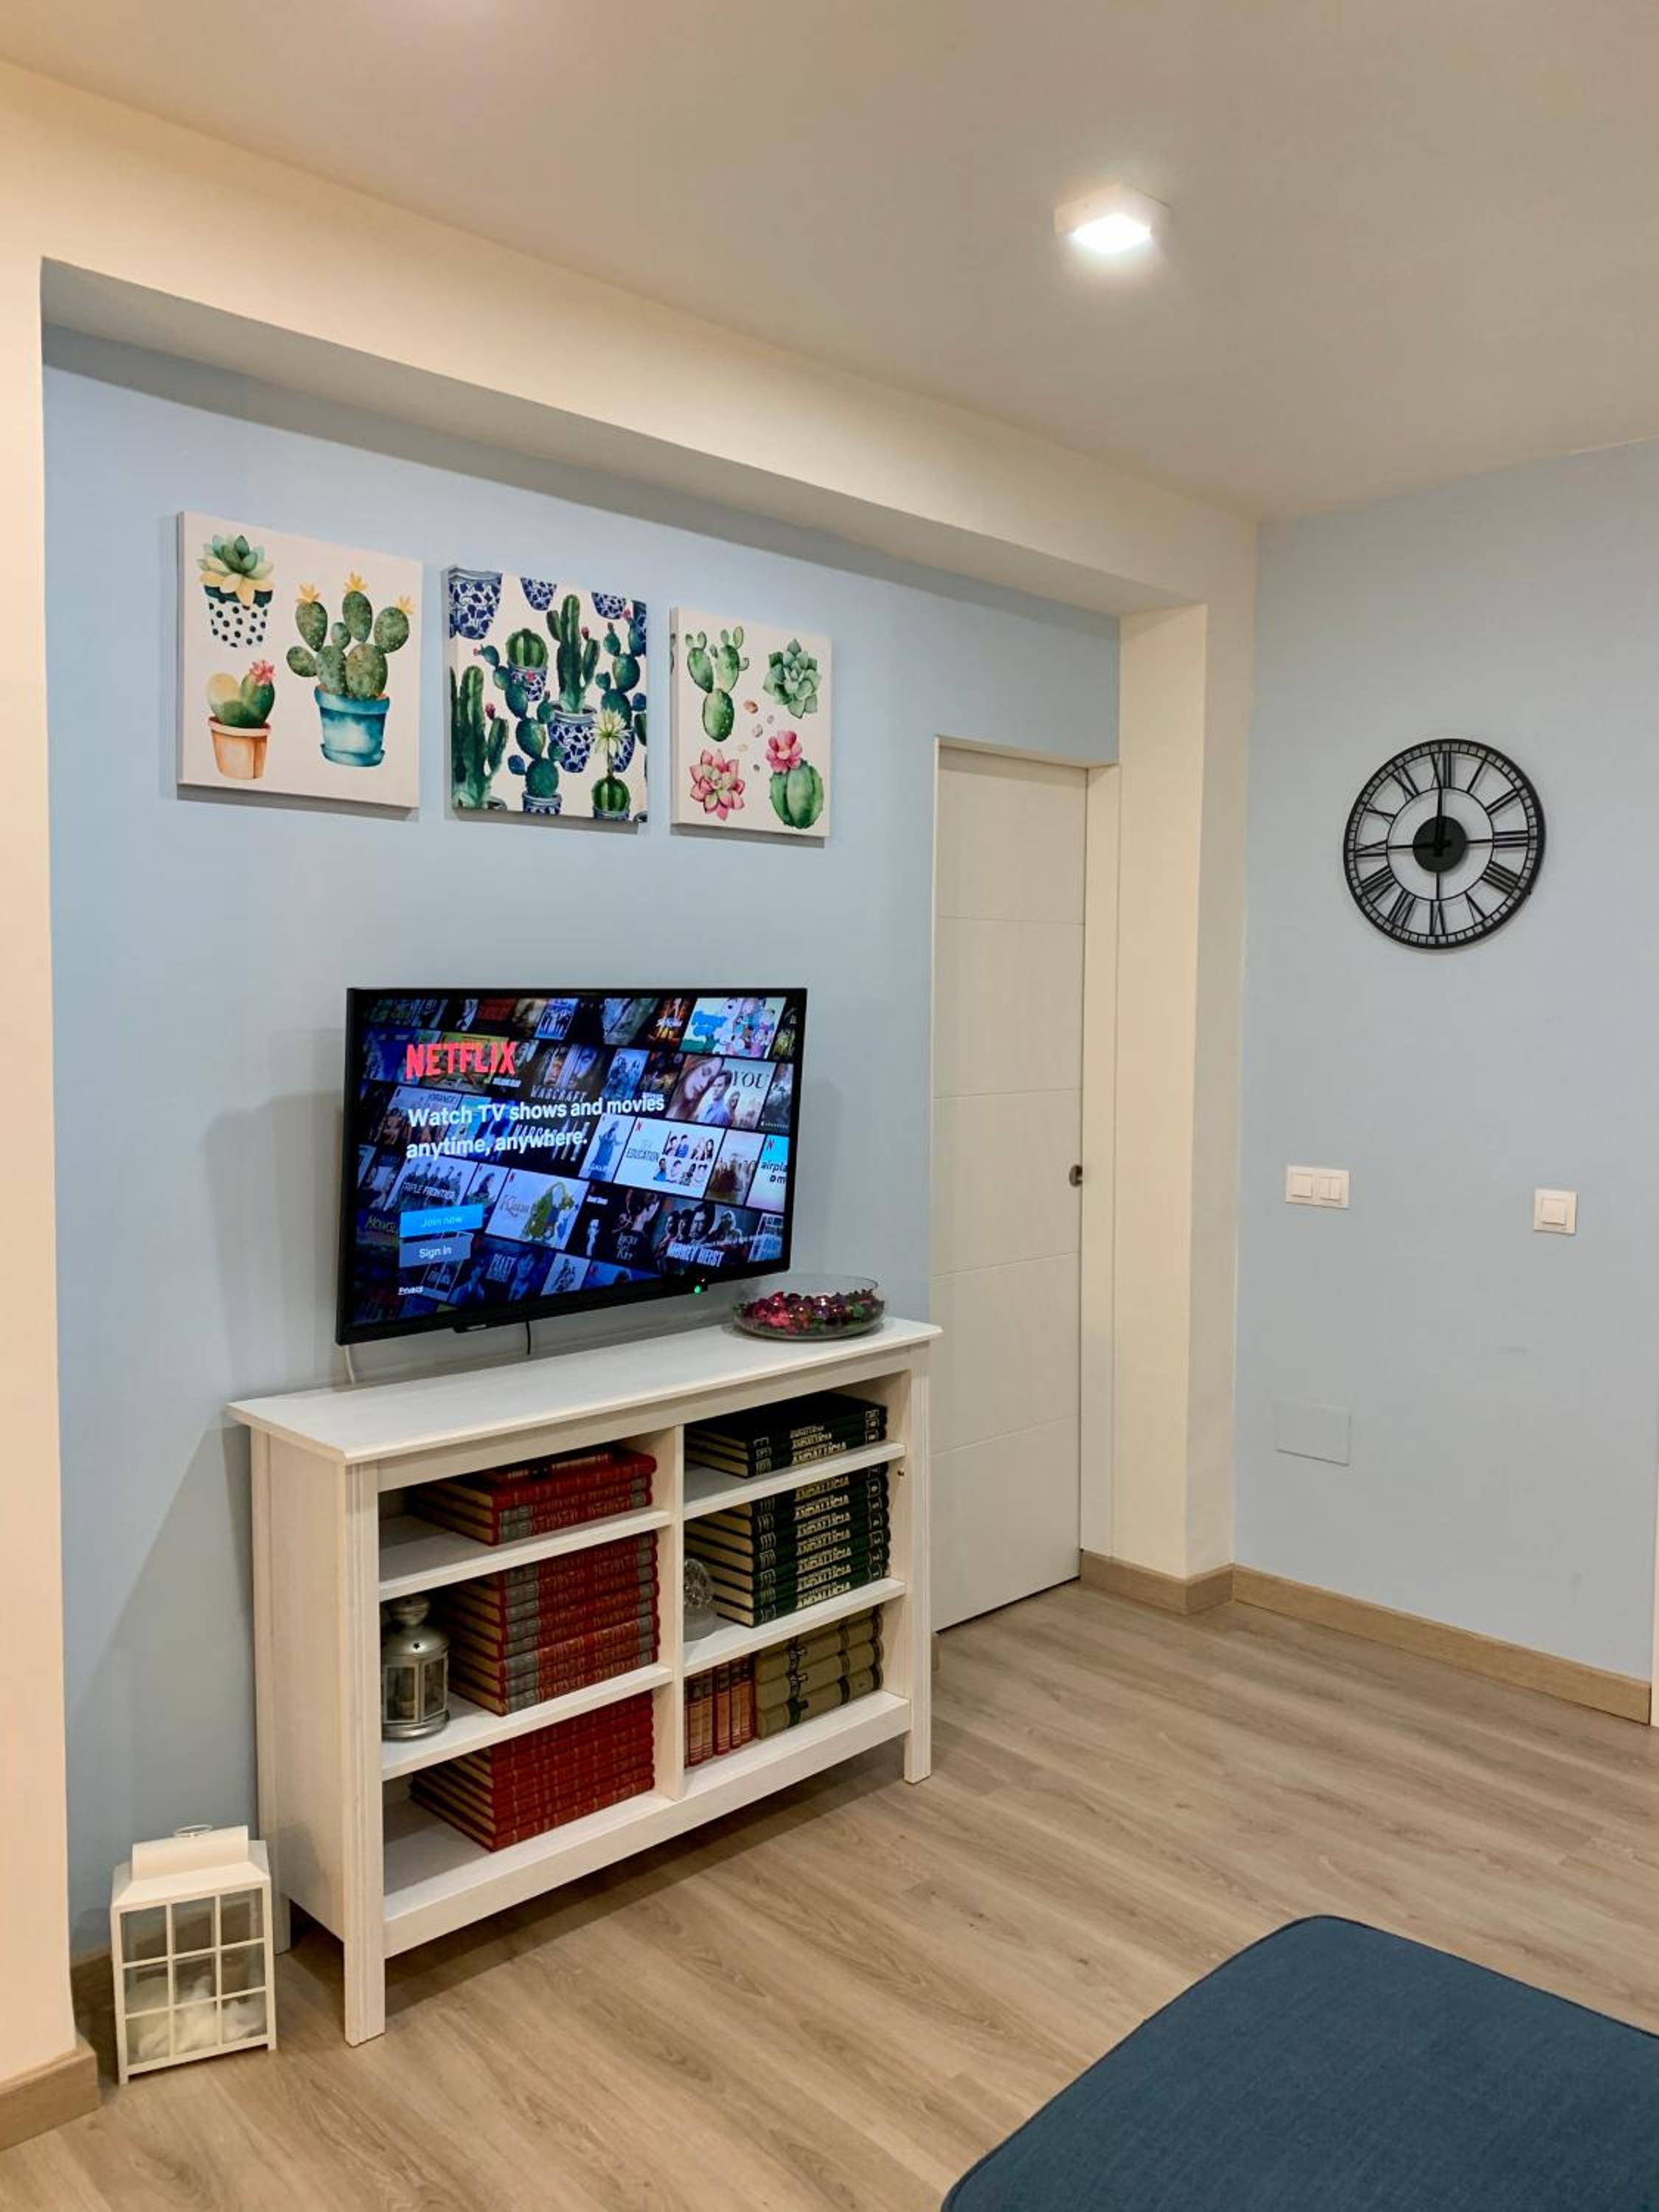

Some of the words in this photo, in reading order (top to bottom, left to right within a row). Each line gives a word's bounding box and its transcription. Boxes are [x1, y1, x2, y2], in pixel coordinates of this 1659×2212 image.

[406, 1040, 517, 1079] NETFLIX
[732, 1070, 770, 1089] YOU
[408, 1105, 473, 1127] Watch
[477, 1103, 508, 1123] TV
[509, 1101, 567, 1120] shows
[570, 1097, 602, 1116] and
[607, 1096, 664, 1114] movies
[406, 1135, 492, 1161] anytime,
[495, 1128, 588, 1154] anywhere.
[421, 1217, 442, 1228] Join
[443, 1216, 462, 1225] now
[418, 1247, 441, 1259] Sign
[442, 1245, 452, 1255] in
[398, 1286, 424, 1295] Privacy
